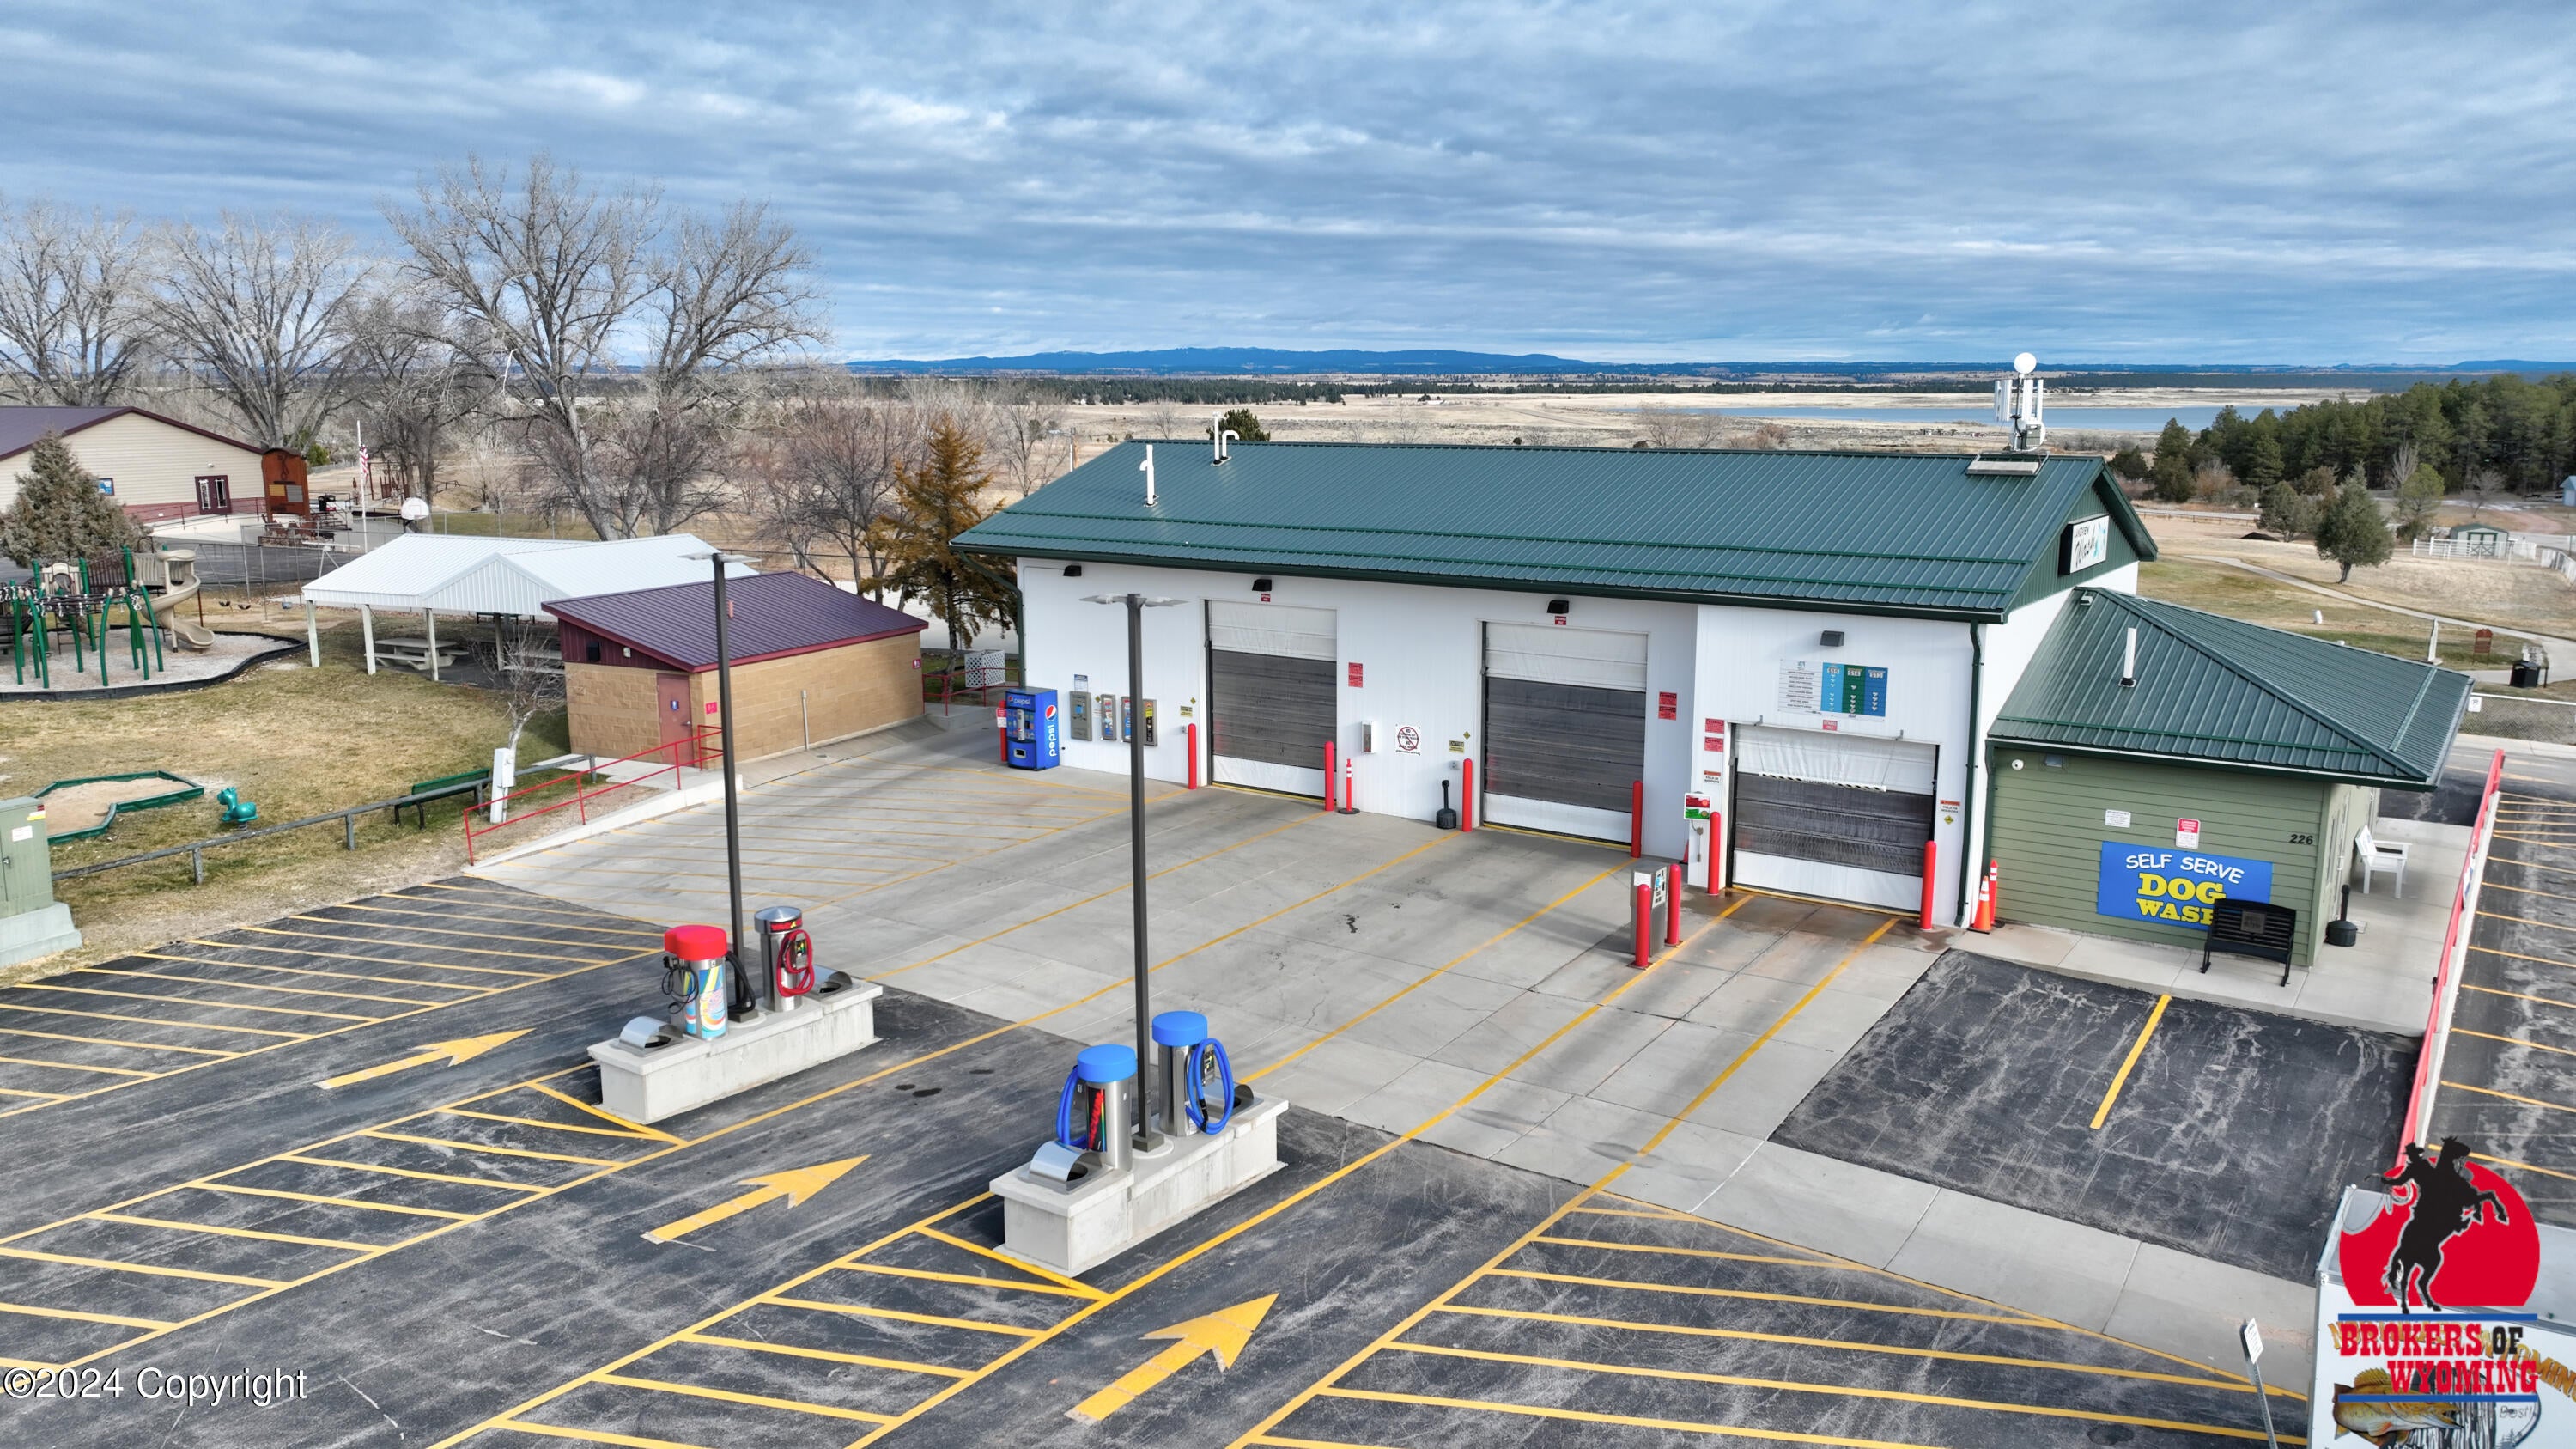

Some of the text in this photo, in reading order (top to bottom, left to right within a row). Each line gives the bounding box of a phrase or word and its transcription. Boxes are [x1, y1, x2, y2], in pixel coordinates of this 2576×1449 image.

[1048, 724, 1057, 757] pepsi
[2288, 833, 2313, 845] 226
[2125, 853, 2245, 884] SELF SERVE
[2137, 872, 2227, 904] DOG
